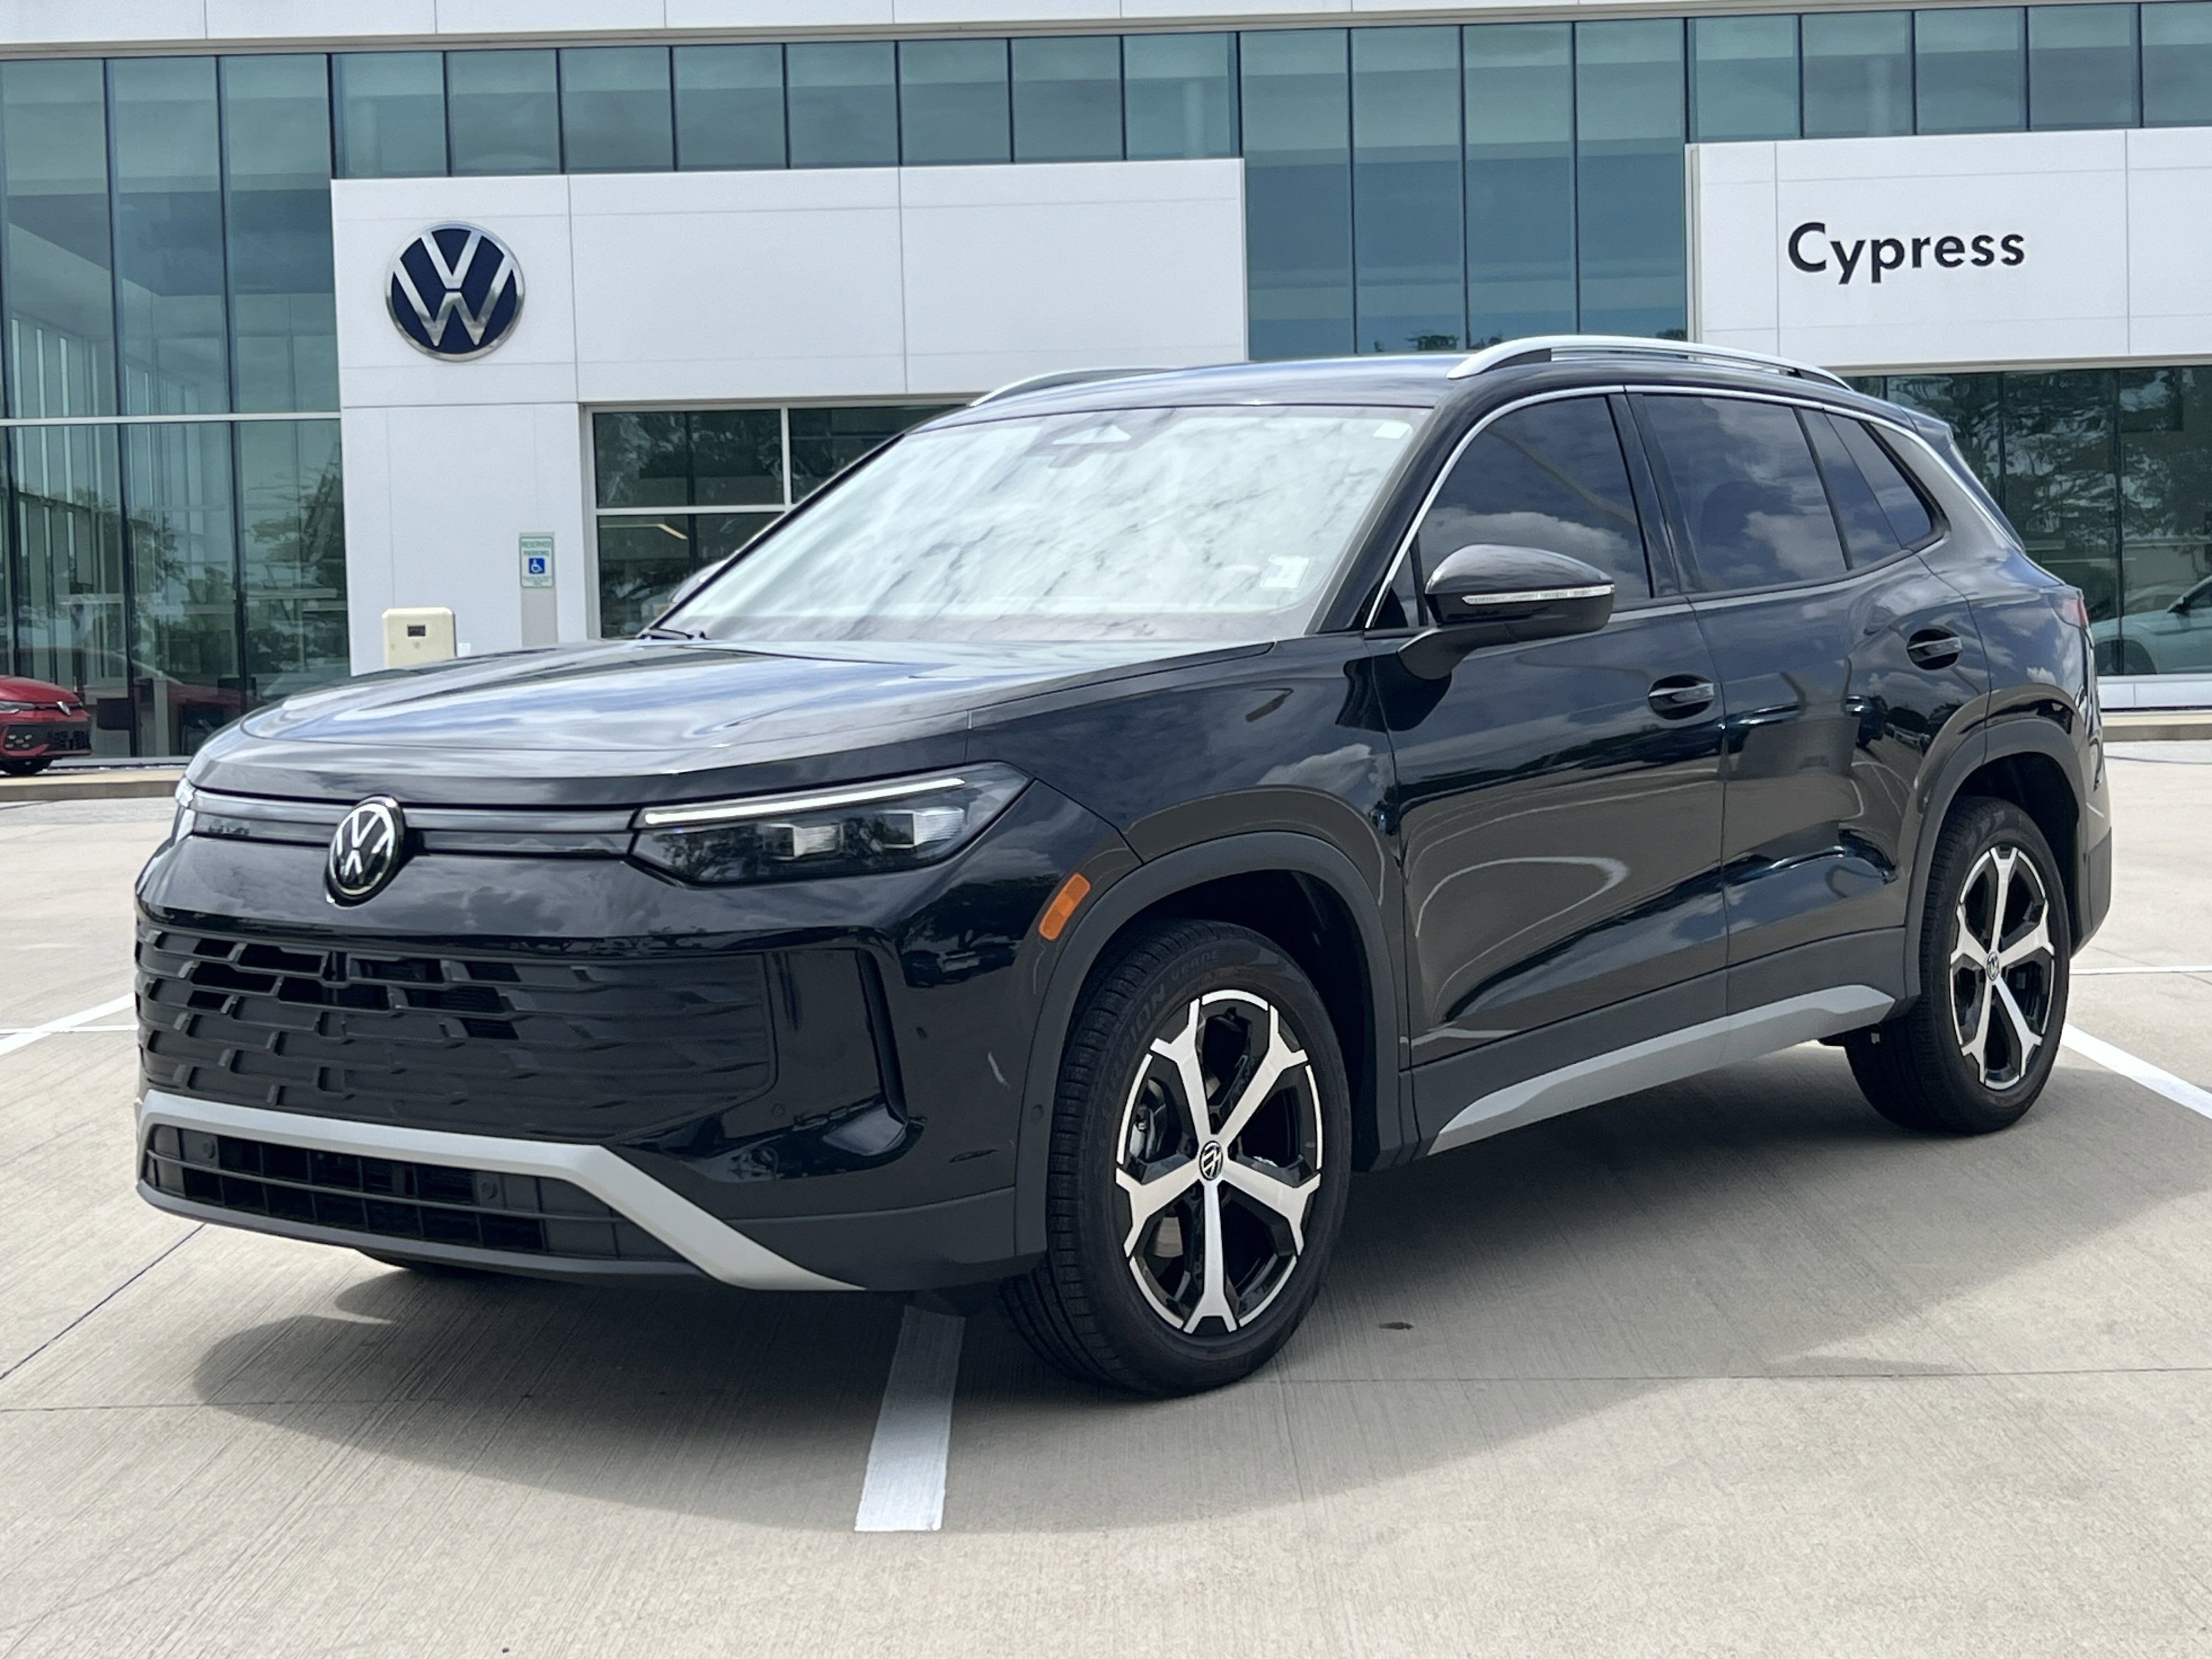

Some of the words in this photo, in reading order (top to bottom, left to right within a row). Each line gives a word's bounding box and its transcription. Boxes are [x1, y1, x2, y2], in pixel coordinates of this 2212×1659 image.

[387, 224, 522, 357] VW
[1788, 222, 2024, 285] Cypress
[332, 804, 394, 891] VW
